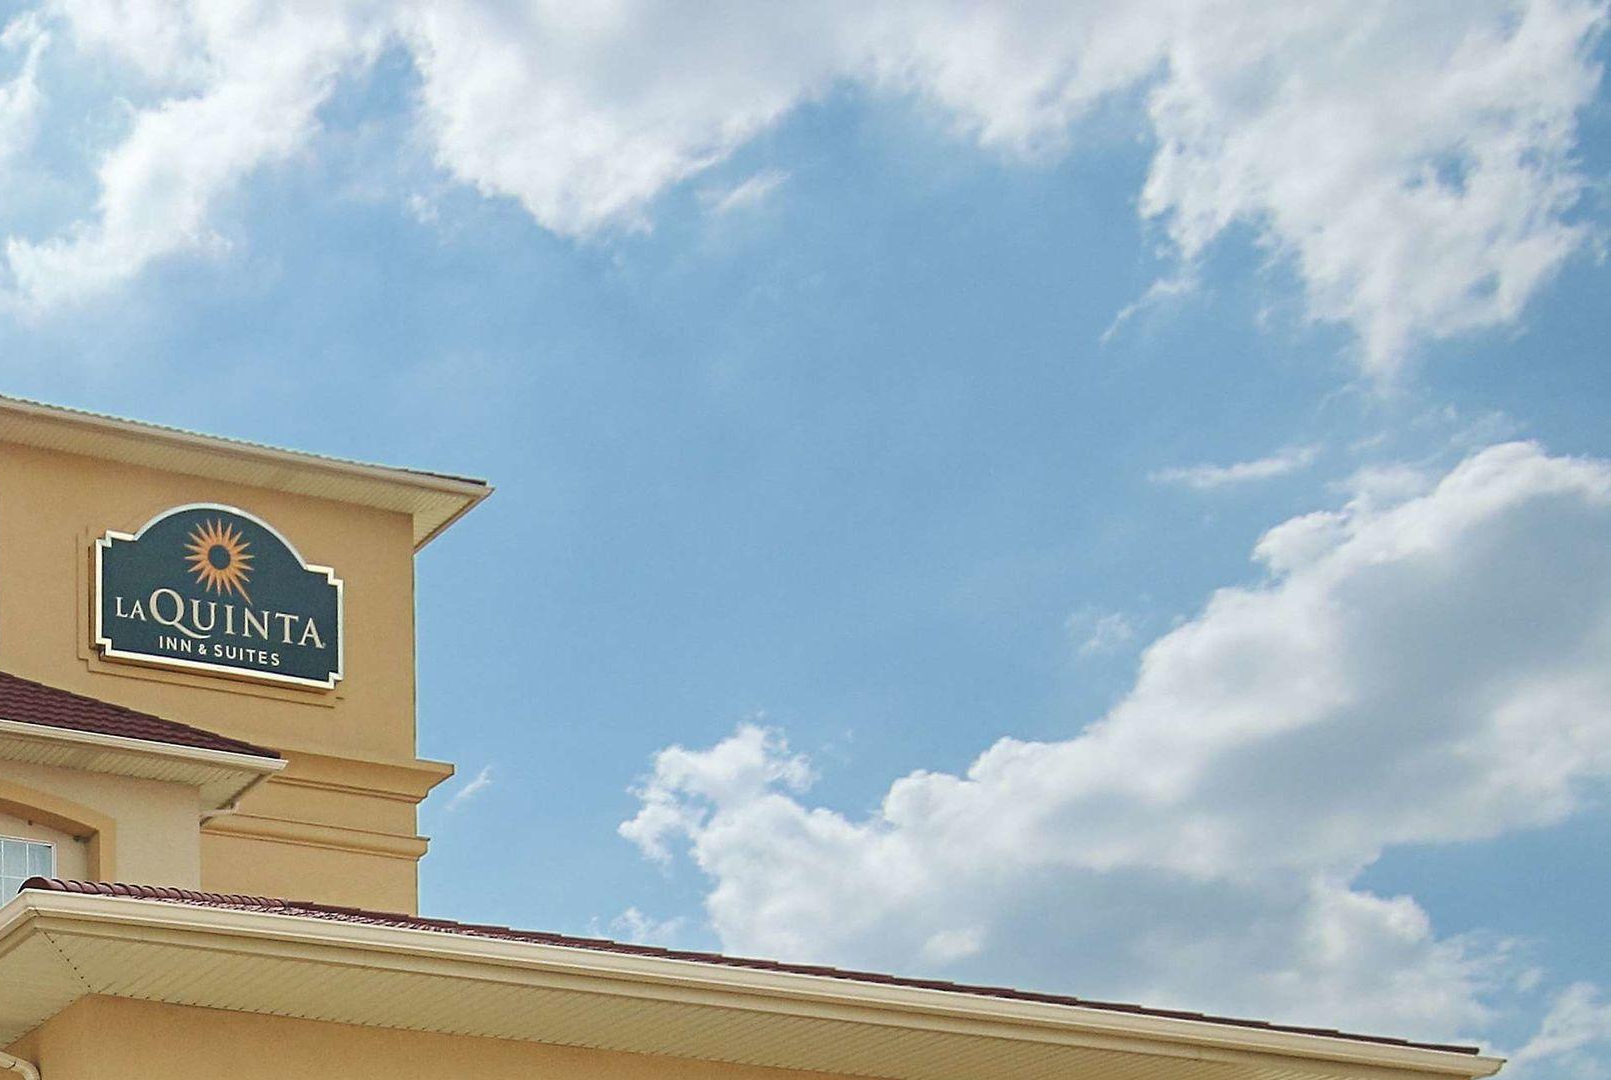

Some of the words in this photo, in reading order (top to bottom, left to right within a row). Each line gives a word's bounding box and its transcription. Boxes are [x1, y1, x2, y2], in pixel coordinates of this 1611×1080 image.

[115, 596, 147, 622] LA
[149, 588, 325, 649] QUINTA
[159, 635, 192, 653] INN
[198, 643, 208, 655] &
[214, 644, 281, 666] SUITES
